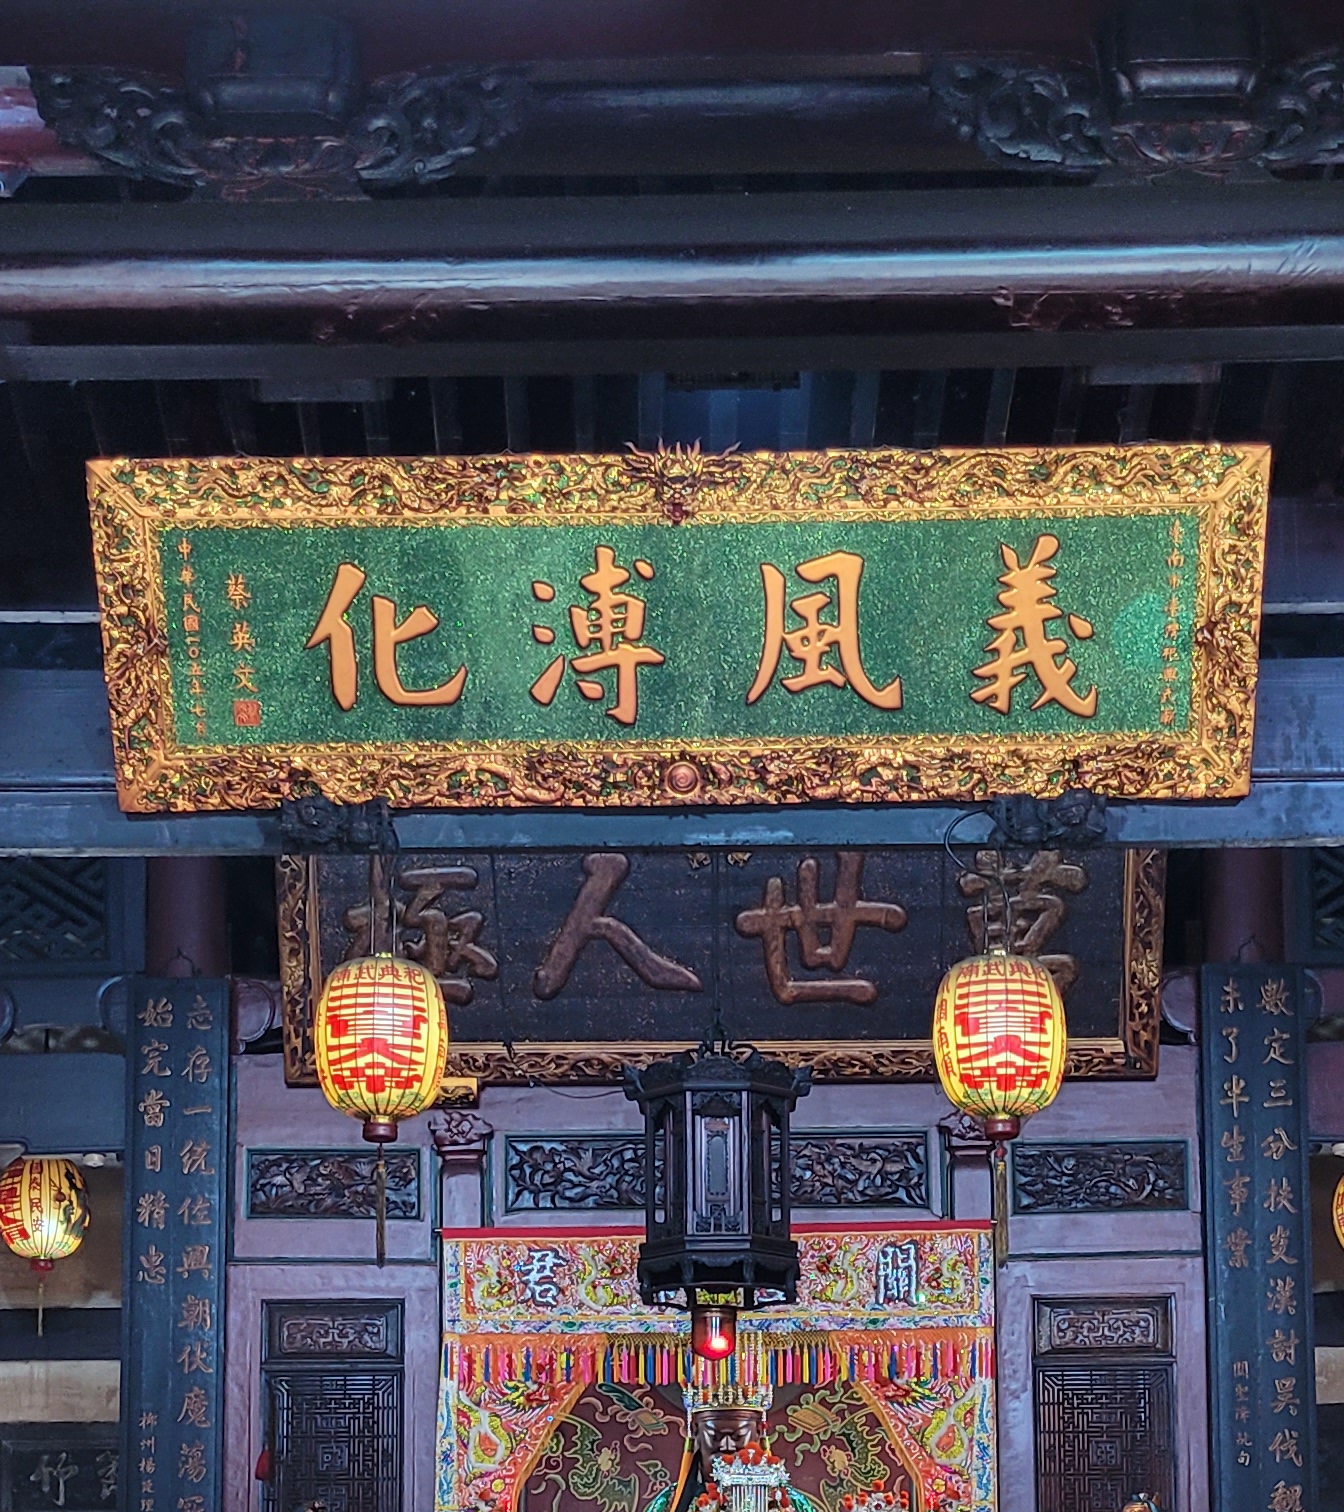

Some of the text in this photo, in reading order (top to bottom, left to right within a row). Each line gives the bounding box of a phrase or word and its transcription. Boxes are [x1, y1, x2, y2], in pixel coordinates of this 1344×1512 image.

[224, 573, 259, 693] 蔡英文
[136, 997, 174, 1284] 始完當日精忠
[1219, 977, 1253, 1268] 未了半生事業
